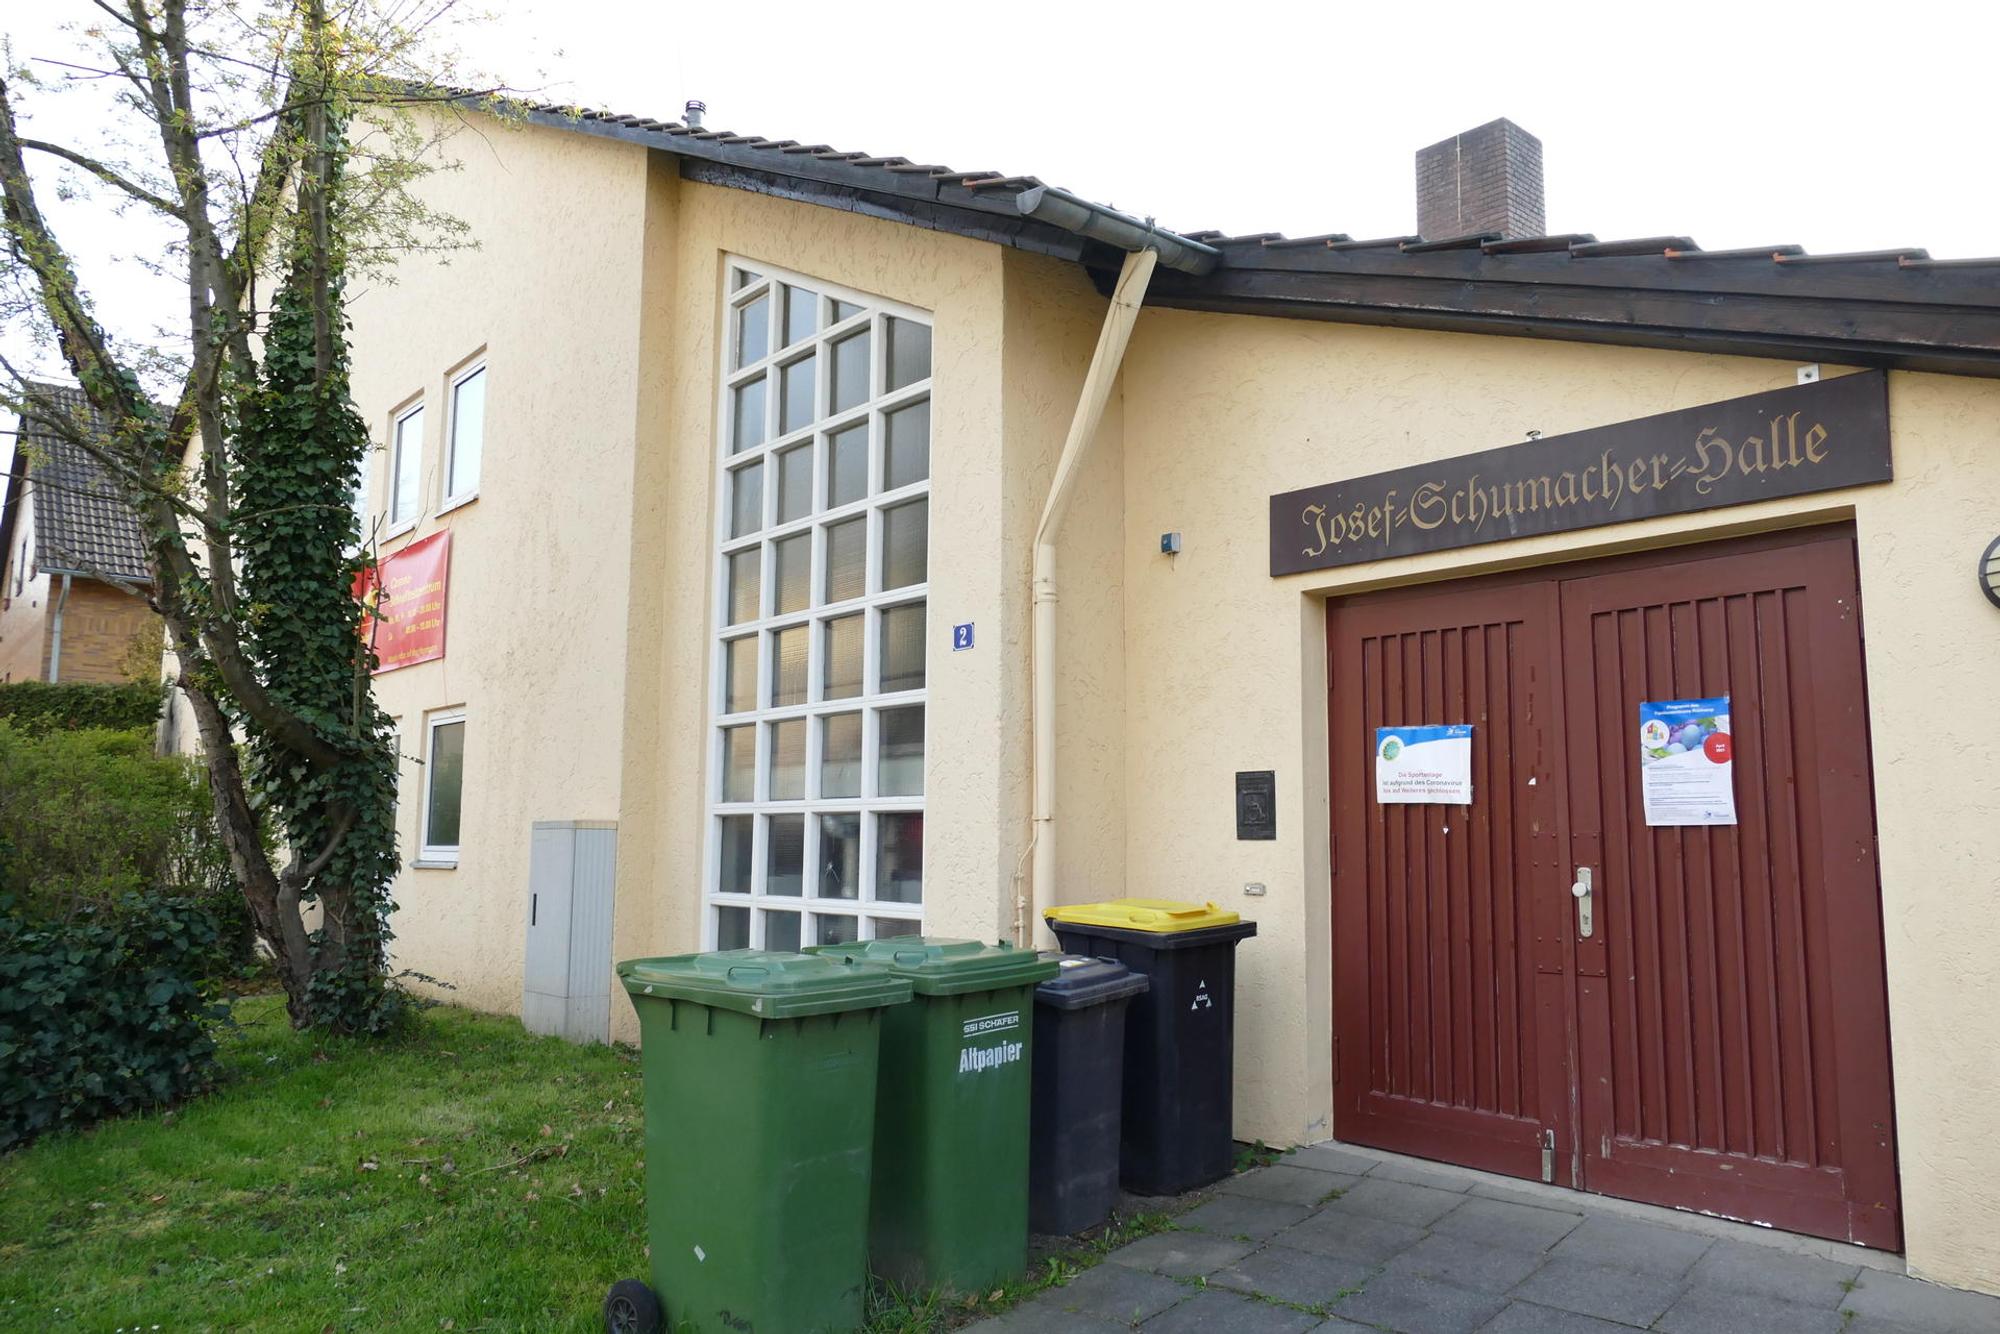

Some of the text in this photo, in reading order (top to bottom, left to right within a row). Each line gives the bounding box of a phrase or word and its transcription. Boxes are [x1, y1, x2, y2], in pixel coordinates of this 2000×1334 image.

[1302, 411, 1830, 559] Josef-Schumacher-Halle
[959, 627, 967, 646] 2
[1390, 779, 1413, 787] aufgrund
[963, 1023, 977, 1033] SSI
[959, 1040, 1023, 1073] Altpapier
